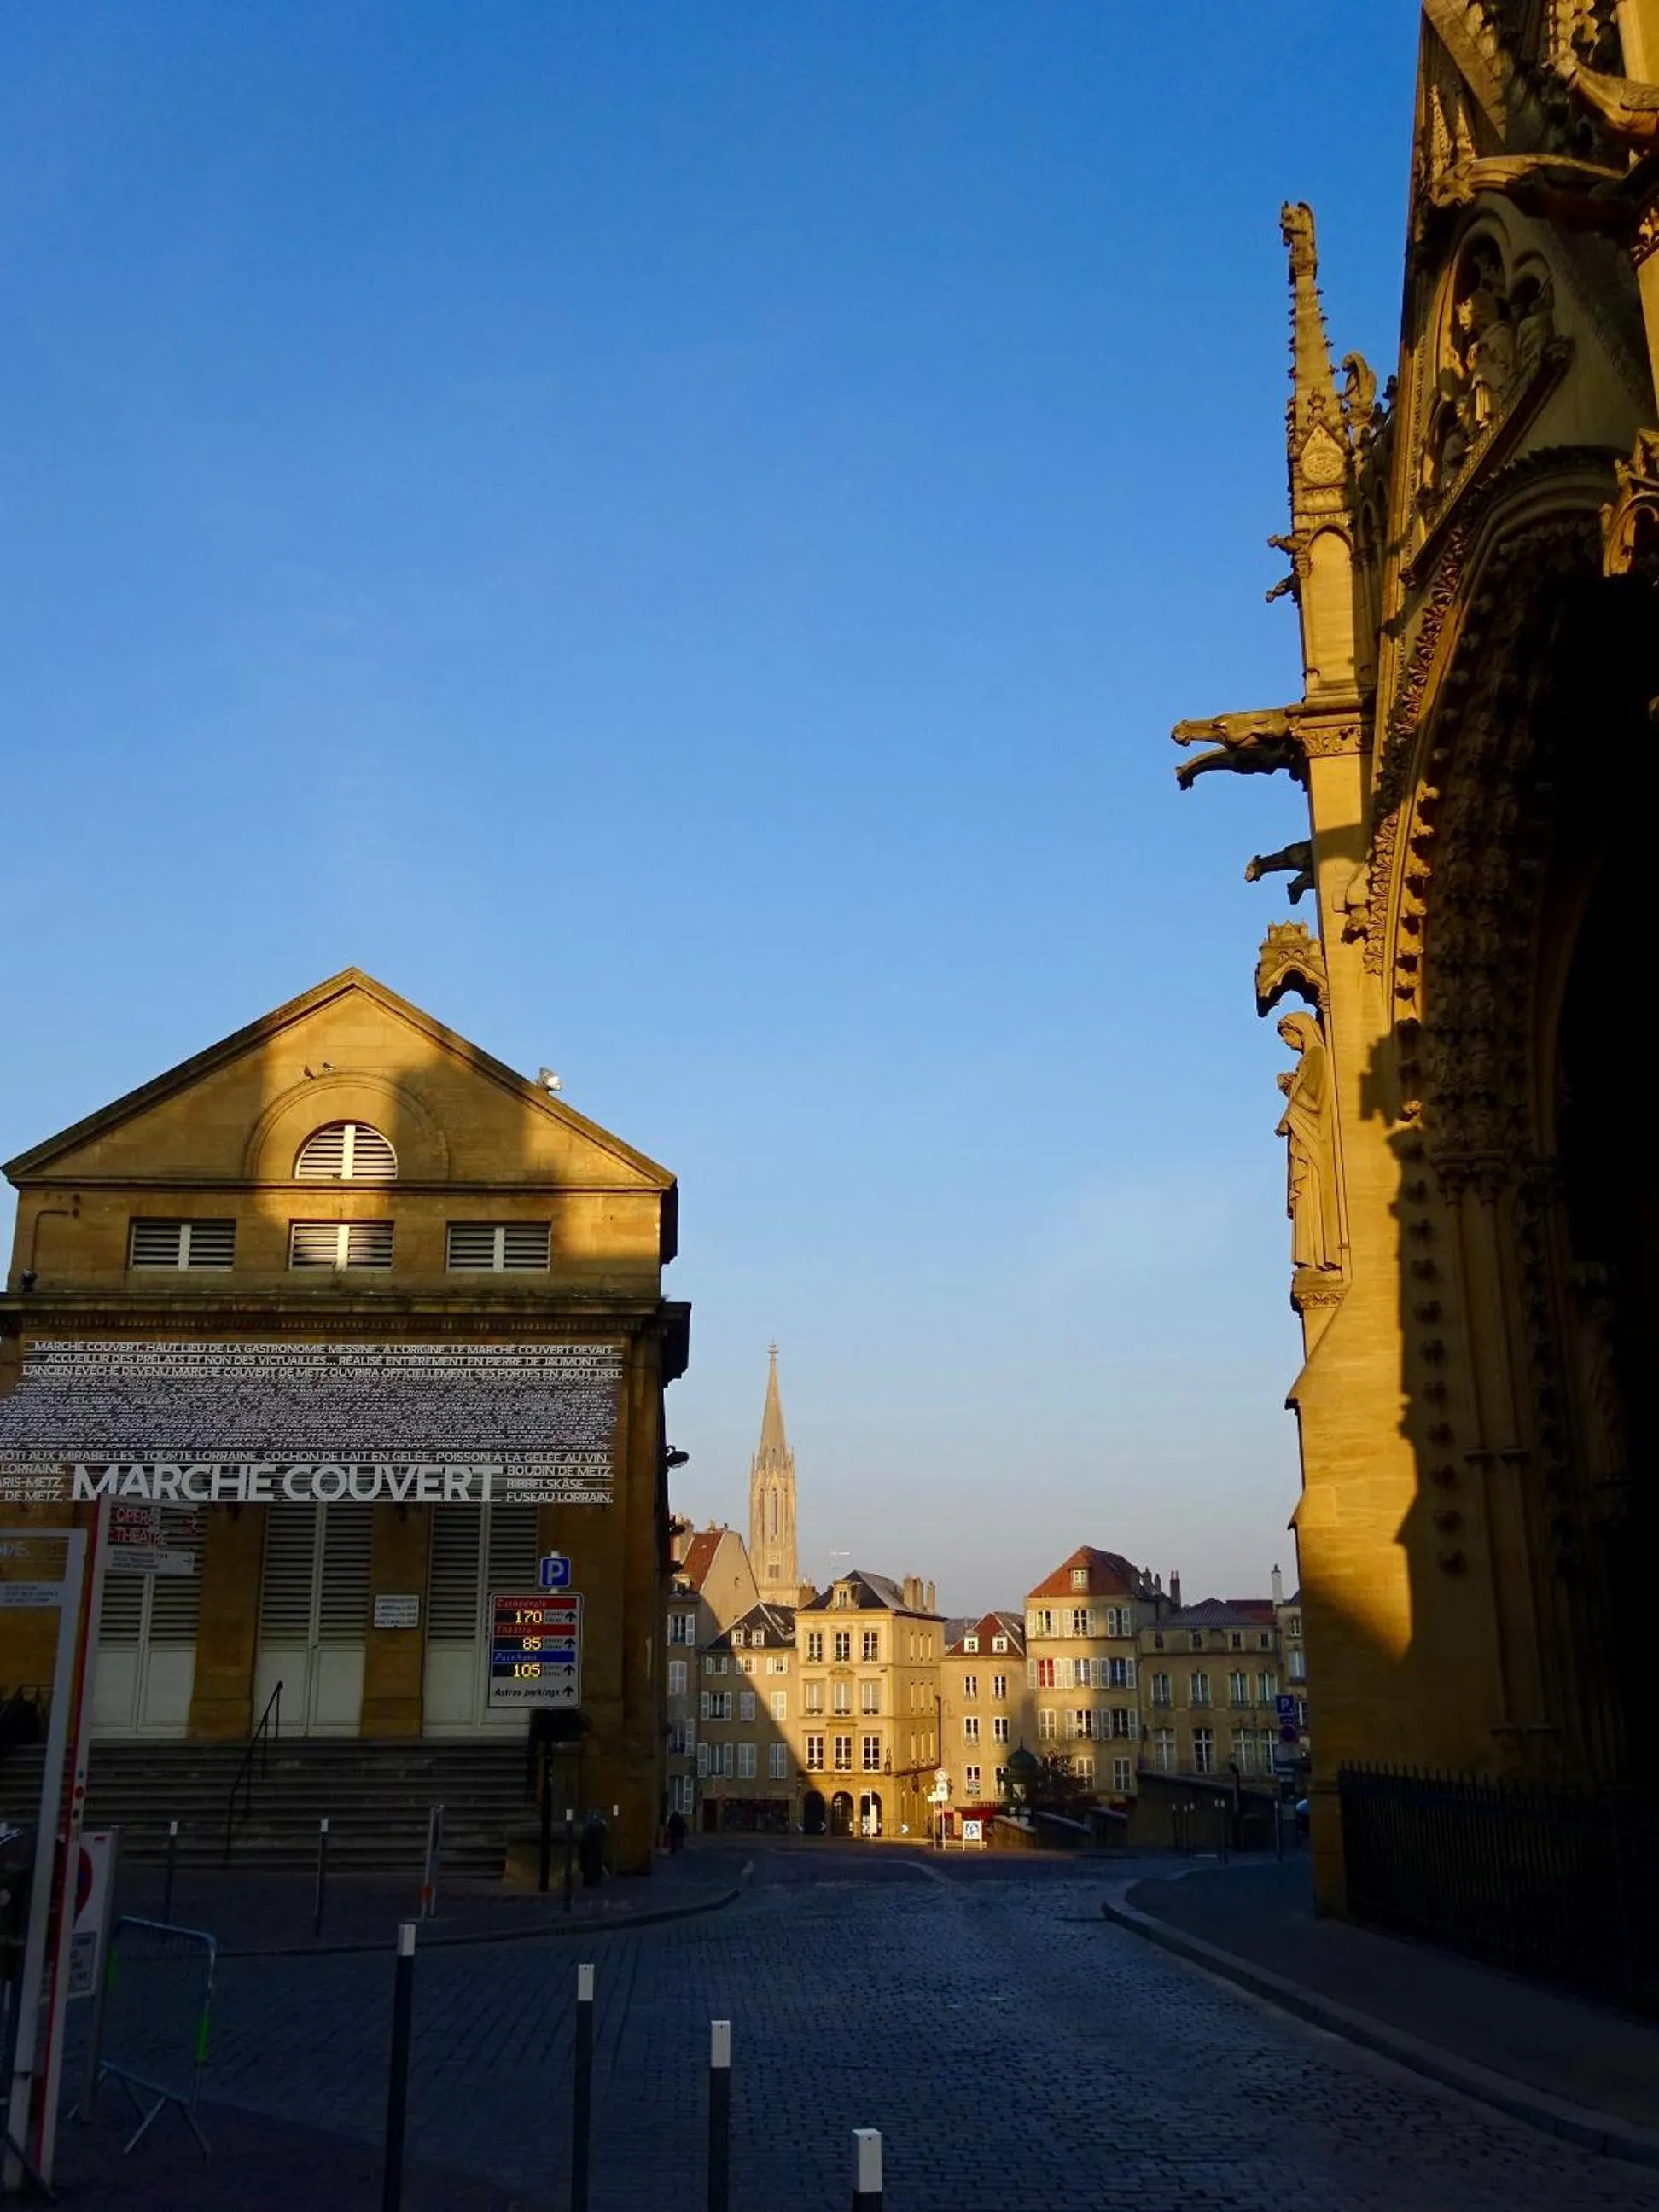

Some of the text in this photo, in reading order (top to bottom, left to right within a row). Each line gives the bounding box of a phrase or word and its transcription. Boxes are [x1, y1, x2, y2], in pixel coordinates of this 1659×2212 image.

[147, 1342, 177, 1352] HAUT
[181, 1342, 205, 1352] LIEU
[209, 1342, 224, 1352] DE
[226, 1342, 241, 1352] LA
[244, 1343, 325, 1353] GASTRONOMIE
[453, 1344, 468, 1353] LE
[519, 1345, 569, 1353] COUVERT
[573, 1345, 614, 1354] DEVAIT
[47, 1354, 109, 1364] ACCUEILLIR
[113, 1354, 133, 1364] DES
[187, 1354, 201, 1364] ET
[205, 1355, 232, 1364] NON
[235, 1355, 255, 1365] DES
[468, 1356, 482, 1365] EN
[486, 1357, 521, 1365] PIERRE
[527, 1357, 541, 1365] DE
[122, 1366, 169, 1376] DEVENU
[224, 1367, 274, 1376] COUVERT
[280, 1367, 294, 1377] DE
[297, 1367, 329, 1377] METZ
[330, 1367, 378, 1377] OUVRIRA
[382, 1368, 471, 1377] OFFICIELLEMENT
[476, 1368, 495, 1377] SES
[498, 1368, 539, 1377] PORTES
[543, 1369, 557, 1377] EN
[29, 1451, 55, 1460] AUX
[141, 1452, 192, 1461] TOURTE
[264, 1452, 318, 1461] COCHON
[322, 1452, 336, 1462] DE
[342, 1452, 369, 1462] LAIT
[372, 1452, 388, 1462] EN
[436, 1452, 491, 1462] POISSON
[506, 1452, 521, 1462] LA
[525, 1452, 561, 1463] GELÉE
[565, 1452, 581, 1463] AU
[585, 1452, 609, 1464] VIN,
[507, 1466, 555, 1476] BOUDIN
[558, 1466, 574, 1476] DE
[72, 1463, 503, 1501] MARCHÉ COUVERT
[5, 1491, 25, 1500] DE
[507, 1492, 556, 1502] FUSEAU
[546, 1560, 564, 1585] P
[515, 1610, 543, 1624] 170
[522, 1636, 542, 1650] 85
[513, 1663, 541, 1678] 105
[1280, 1697, 1290, 1711] P
